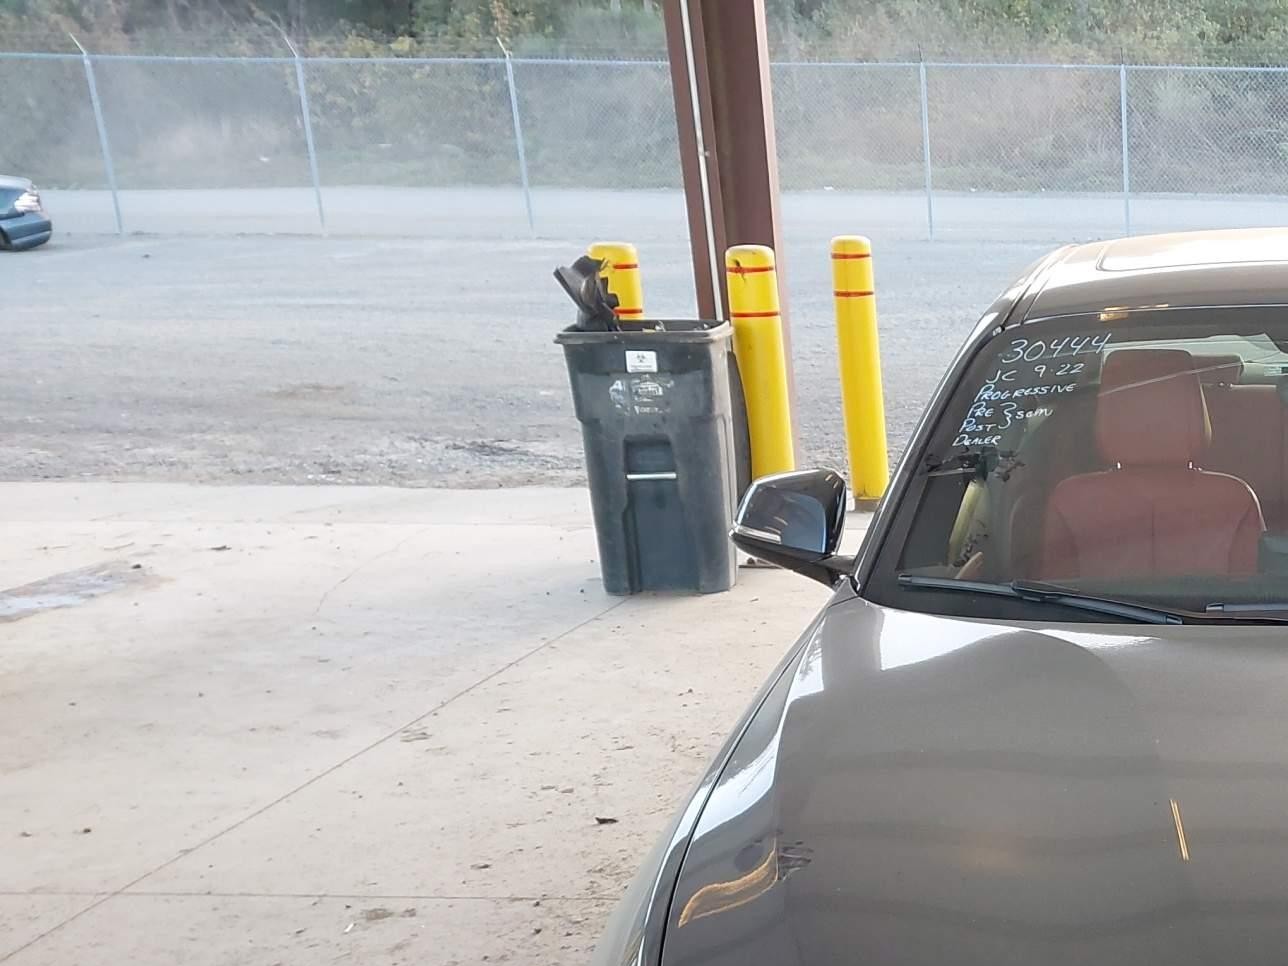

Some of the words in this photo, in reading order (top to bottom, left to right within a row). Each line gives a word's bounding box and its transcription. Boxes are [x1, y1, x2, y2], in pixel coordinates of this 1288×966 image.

[1002, 333, 1112, 363] 30444
[974, 383, 1077, 402] PROGRESSIVE
[967, 401, 995, 418] PRE
[959, 417, 997, 432] POST
[952, 434, 1001, 446] DEALER
